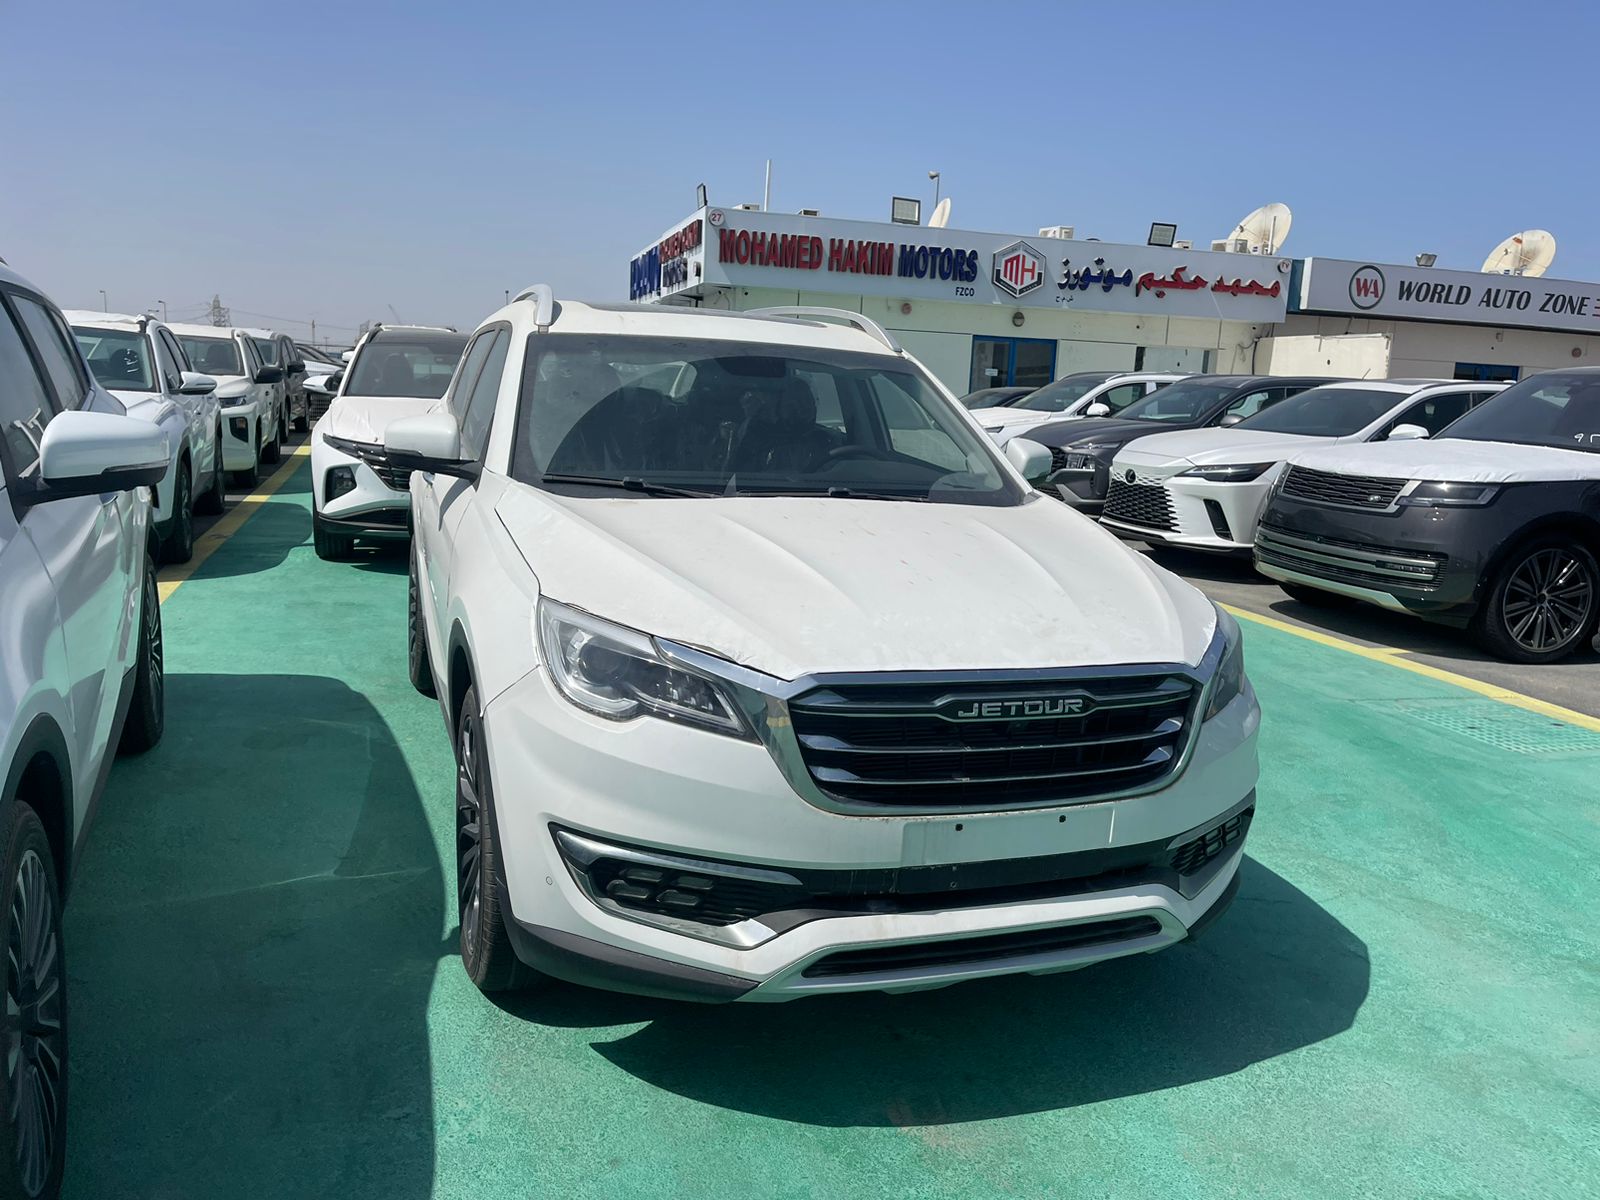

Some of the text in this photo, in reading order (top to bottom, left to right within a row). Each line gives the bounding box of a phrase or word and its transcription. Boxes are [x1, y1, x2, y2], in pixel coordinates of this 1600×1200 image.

[711, 213, 722, 222] 27
[718, 228, 824, 270] MOHAMED
[828, 237, 894, 276] HAKIM
[898, 244, 978, 283] MOTORS
[1003, 253, 1037, 286] MH
[1057, 256, 1133, 293] موتورز
[1135, 265, 1208, 298] حكيم
[1211, 275, 1281, 298] محمد
[1355, 277, 1379, 299] WA
[955, 286, 976, 297] FZCO
[1398, 280, 1591, 316] WORLD AUTO ZONE
[957, 699, 1084, 718] JETOUR
